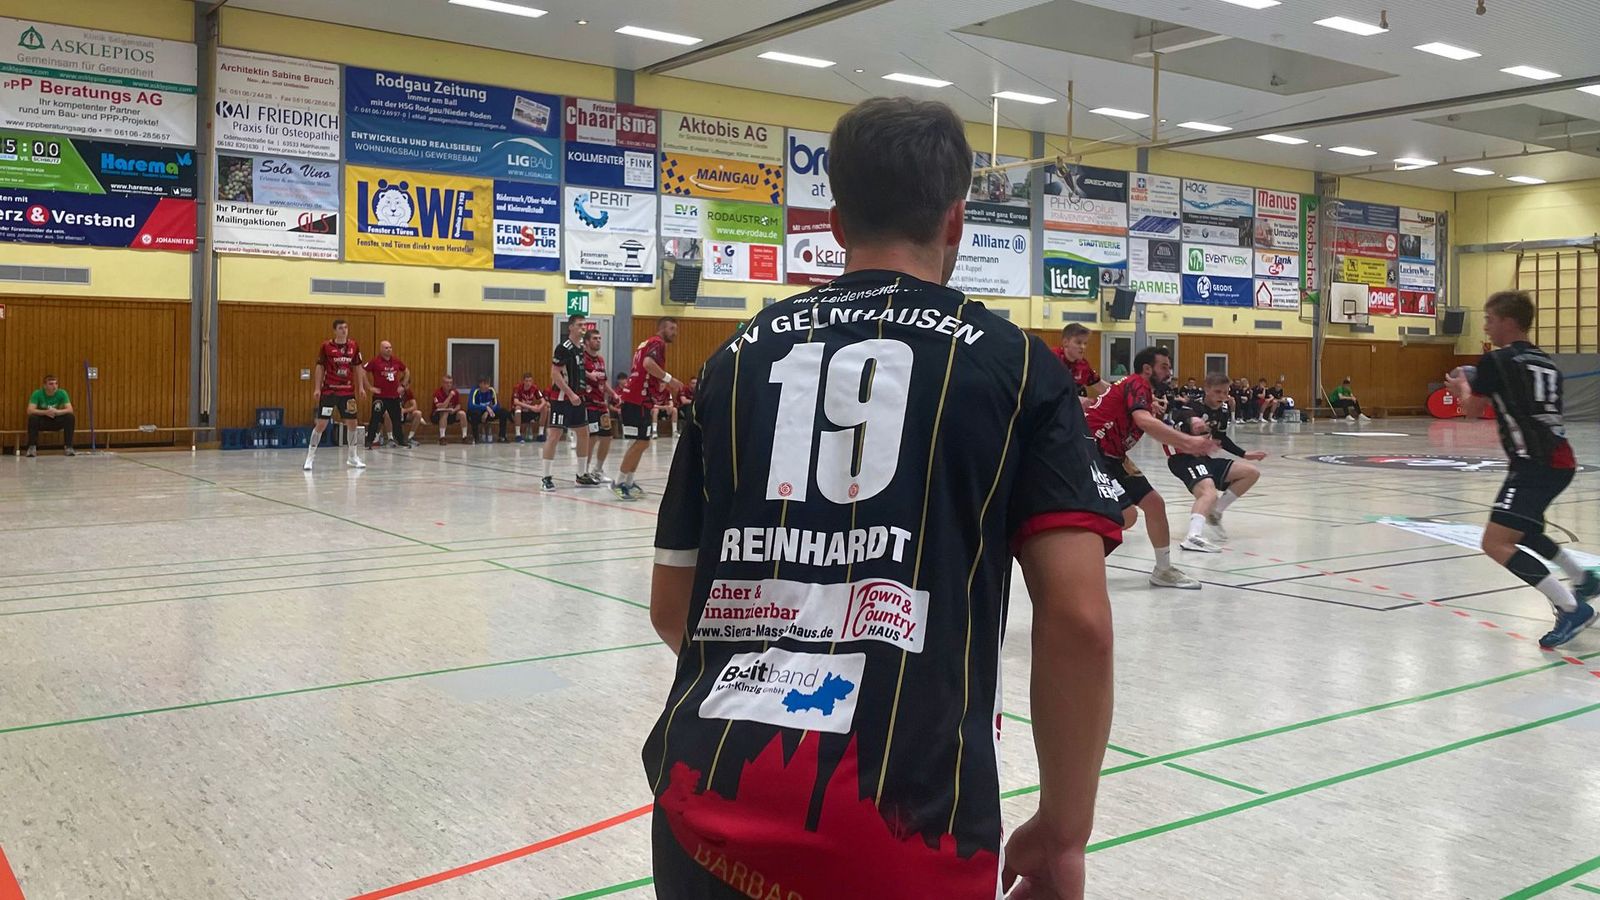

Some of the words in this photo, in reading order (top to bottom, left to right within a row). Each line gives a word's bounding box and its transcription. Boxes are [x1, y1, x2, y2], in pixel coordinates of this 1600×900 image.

[51, 39, 155, 63] ASKLEPIOS
[17, 53, 78, 69] Gemeinsam
[81, 61, 95, 70] für
[98, 63, 154, 78] Gesundheit
[220, 64, 269, 76] Architektin
[272, 69, 301, 81] Sabine
[304, 74, 334, 86] Brauch
[40, 80, 131, 104] Beratungs
[136, 91, 163, 106] AG
[376, 73, 431, 93] Rodgau
[434, 82, 488, 102] Zeitung
[39, 98, 51, 106] Ihr
[53, 99, 107, 112] kompetenter
[110, 105, 140, 115] Partner
[370, 99, 383, 107] mit
[385, 101, 397, 109] der
[399, 102, 414, 112] HSG
[415, 104, 492, 121] Rodgau/Nieder-Roden
[444, 98, 458, 106] Ball
[19, 106, 39, 115] rund
[58, 110, 79, 118] Bau-
[81, 112, 97, 120] und
[100, 113, 159, 127] PPP-Projekte!
[216, 101, 250, 119] KAI
[258, 106, 338, 129] FRIEDRICH
[566, 105, 656, 135] Chaarisma
[233, 121, 262, 134] Praxis
[265, 124, 279, 136] für
[282, 127, 339, 142] Osteopathie
[679, 116, 740, 138] Aktobis
[744, 125, 768, 142] AG
[351, 131, 408, 146] ENTWICKELN
[409, 138, 428, 147] UND
[429, 141, 482, 153] REALISIEREN
[355, 143, 419, 157] WOHNUNGSBAU
[425, 151, 478, 163] GEWERBEBAU
[507, 154, 553, 170] LIGBAU
[101, 153, 178, 175] Harema
[260, 160, 294, 174] Solo
[300, 164, 331, 179] Vino
[630, 158, 652, 168] FINK
[696, 168, 760, 186] MAINGAU
[110, 183, 163, 193] www.harema.de
[812, 183, 826, 197] at
[31, 207, 45, 222] &
[52, 209, 135, 229] Verstand
[216, 204, 228, 212] Ihr
[231, 205, 263, 216] Partner
[266, 208, 279, 216] für
[708, 211, 779, 226] RODAUSTROM
[216, 215, 287, 228] Mailingaktionen
[368, 225, 390, 234] Fenster
[396, 228, 414, 236] Türen
[497, 223, 556, 238] FENSTER
[155, 236, 194, 245] JOHANNITER
[497, 235, 556, 248] HAUSTÜR
[716, 227, 778, 240] www.ev-rodau.de
[972, 233, 1010, 250] Allianz
[357, 238, 379, 248] Fenster
[381, 240, 393, 248] und
[394, 241, 411, 249] Türen
[412, 242, 430, 251] direkt
[446, 244, 474, 253] Hersteller
[1079, 238, 1121, 250] STADTWERKE
[1307, 214, 1318, 291] Rosbacher
[1206, 253, 1248, 265] EVENTWERK
[1050, 267, 1092, 293] Licher
[1130, 280, 1179, 294] BARMER
[1212, 284, 1233, 292] GEODIS
[725, 326, 760, 354] TV
[771, 308, 985, 347] GELNHAUSEN
[766, 338, 914, 505] 19
[720, 525, 912, 567] REINHARDT
[857, 582, 906, 609] Town
[853, 602, 917, 640] Country
[867, 627, 900, 646] HAUS
